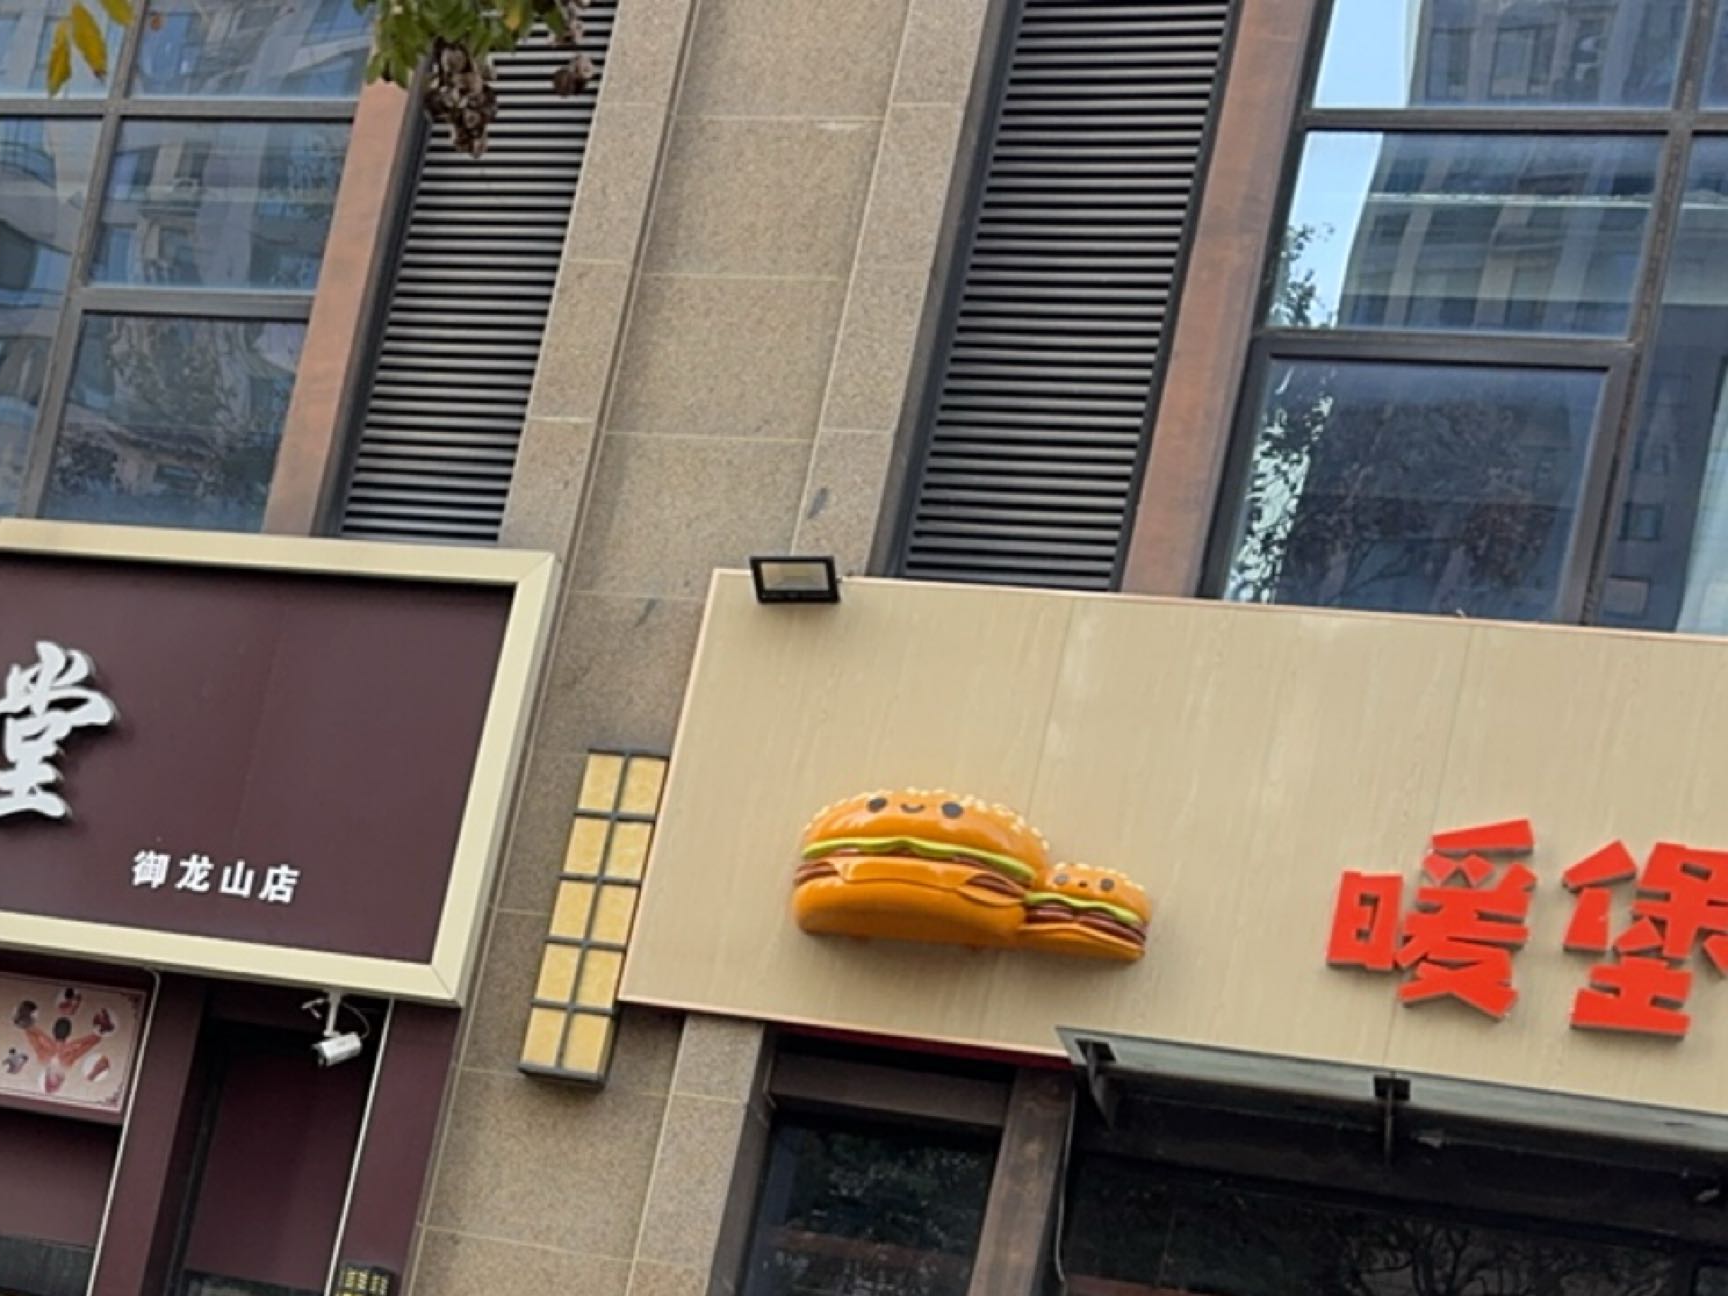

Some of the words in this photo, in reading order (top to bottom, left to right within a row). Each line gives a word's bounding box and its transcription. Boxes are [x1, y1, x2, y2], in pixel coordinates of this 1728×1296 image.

[132, 850, 300, 903] 御龙山店
[1326, 818, 1728, 1038] 暖堡
